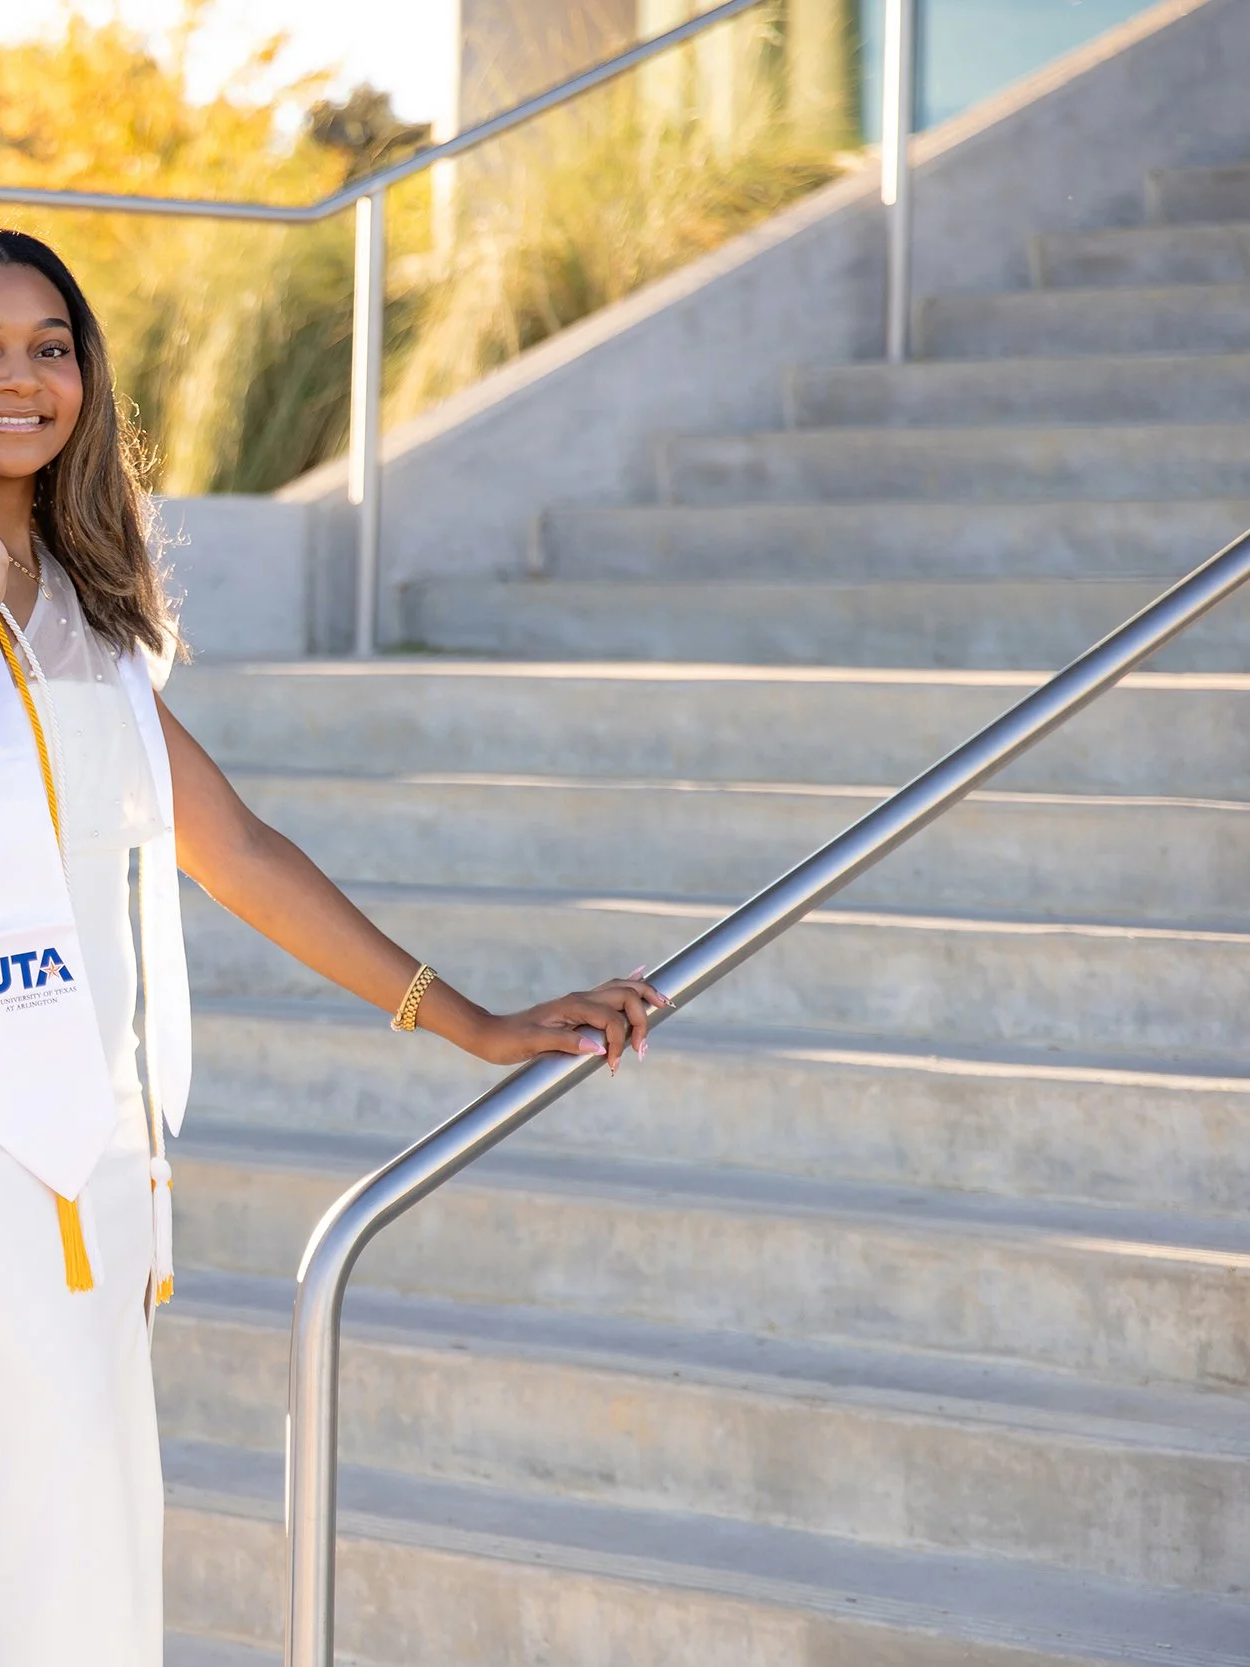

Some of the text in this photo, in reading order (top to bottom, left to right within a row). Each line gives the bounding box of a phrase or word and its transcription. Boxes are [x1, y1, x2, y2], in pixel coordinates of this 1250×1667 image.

[0, 992, 42, 1005] UNIVERSITY
[43, 990, 54, 998] OF
[54, 986, 77, 995] TEXAS
[17, 998, 58, 1010] ARLINGTON
